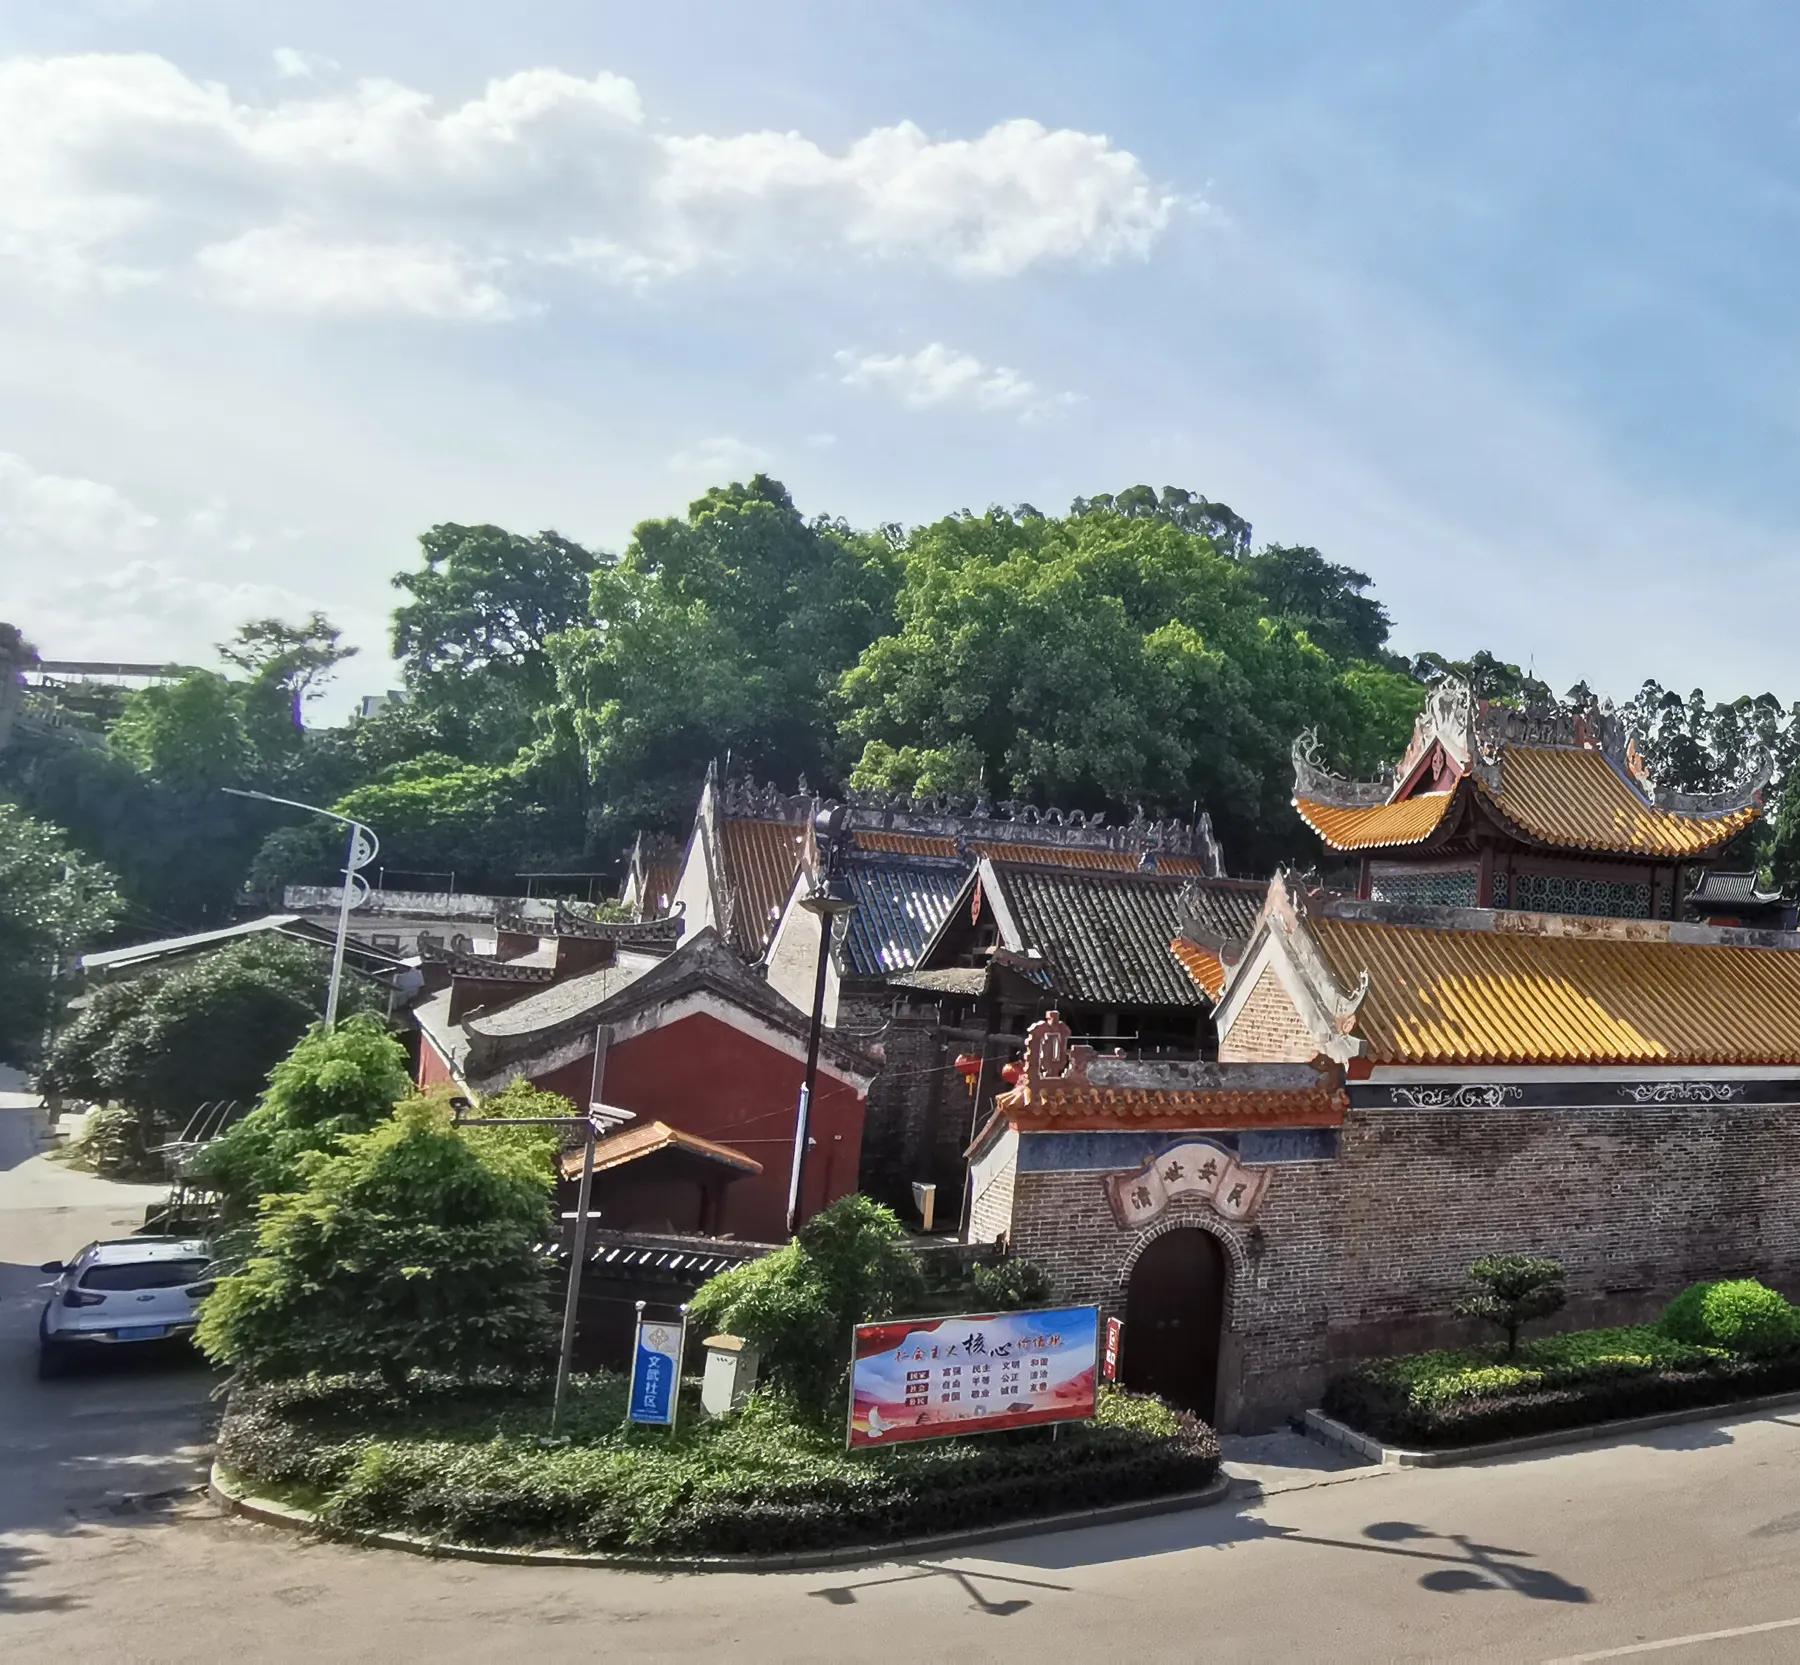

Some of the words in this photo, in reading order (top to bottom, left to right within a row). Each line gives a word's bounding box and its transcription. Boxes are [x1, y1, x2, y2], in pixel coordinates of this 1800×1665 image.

[943, 1367, 962, 1377] 富强
[973, 1364, 991, 1374] 民主
[1003, 1360, 1021, 1371] 文明
[908, 1384, 928, 1393] 社会
[973, 1376, 990, 1387] 平等
[1002, 1373, 1019, 1383] 公正
[1030, 1370, 1048, 1380] 法治
[941, 1393, 961, 1403] 爱国
[971, 1390, 990, 1400] 敬业
[1001, 1386, 1019, 1396] 诚信
[1029, 1382, 1048, 1393] 友善
